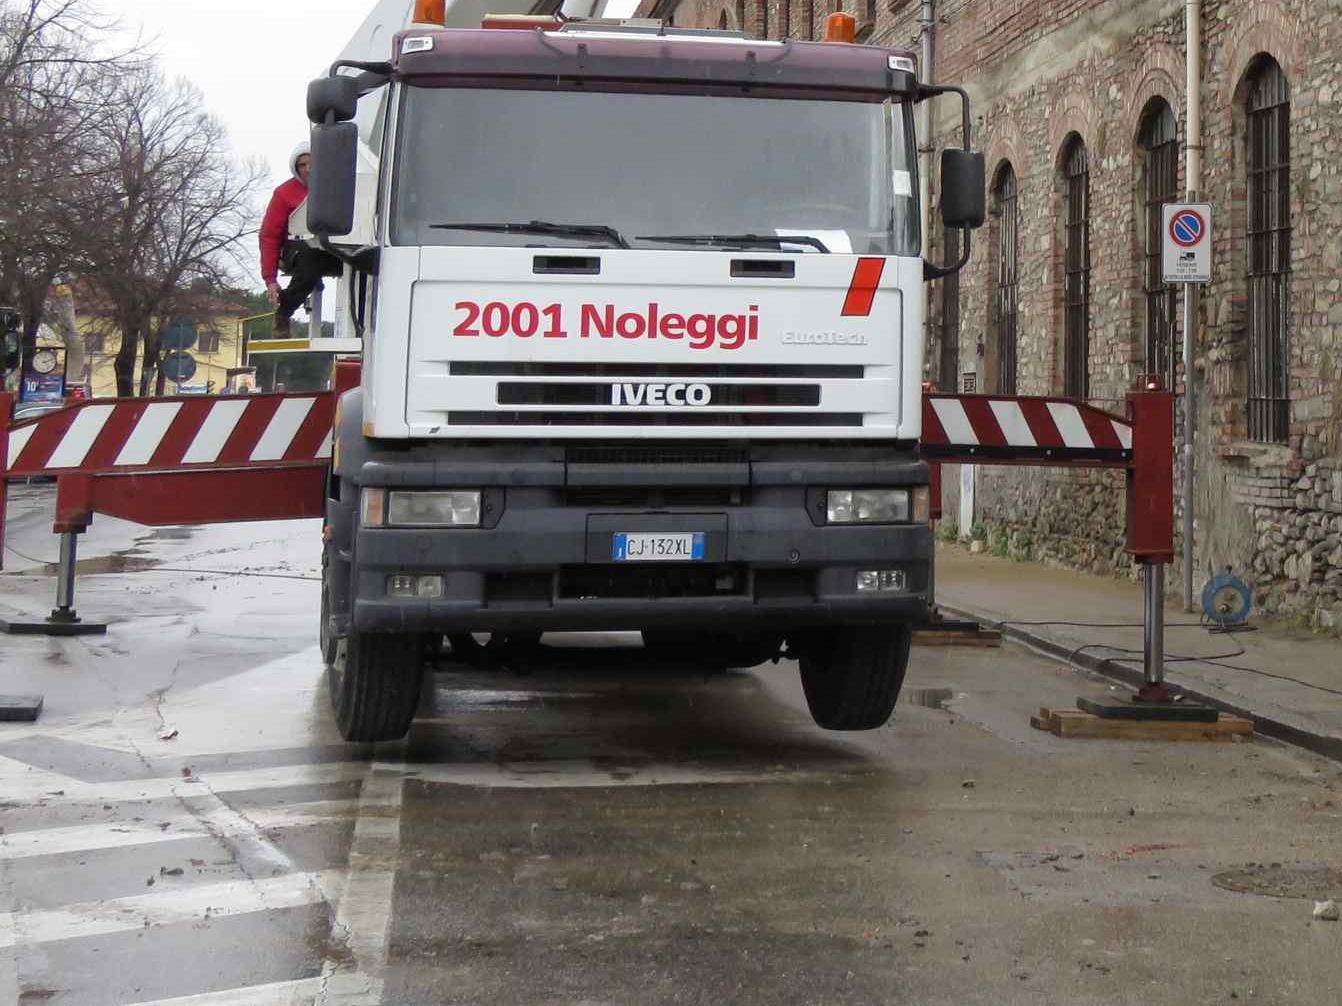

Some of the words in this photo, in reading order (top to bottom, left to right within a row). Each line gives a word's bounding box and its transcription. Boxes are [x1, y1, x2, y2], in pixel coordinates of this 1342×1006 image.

[453, 302, 567, 338] 2001
[581, 303, 758, 350] Noleggi
[611, 383, 711, 406] IVECO
